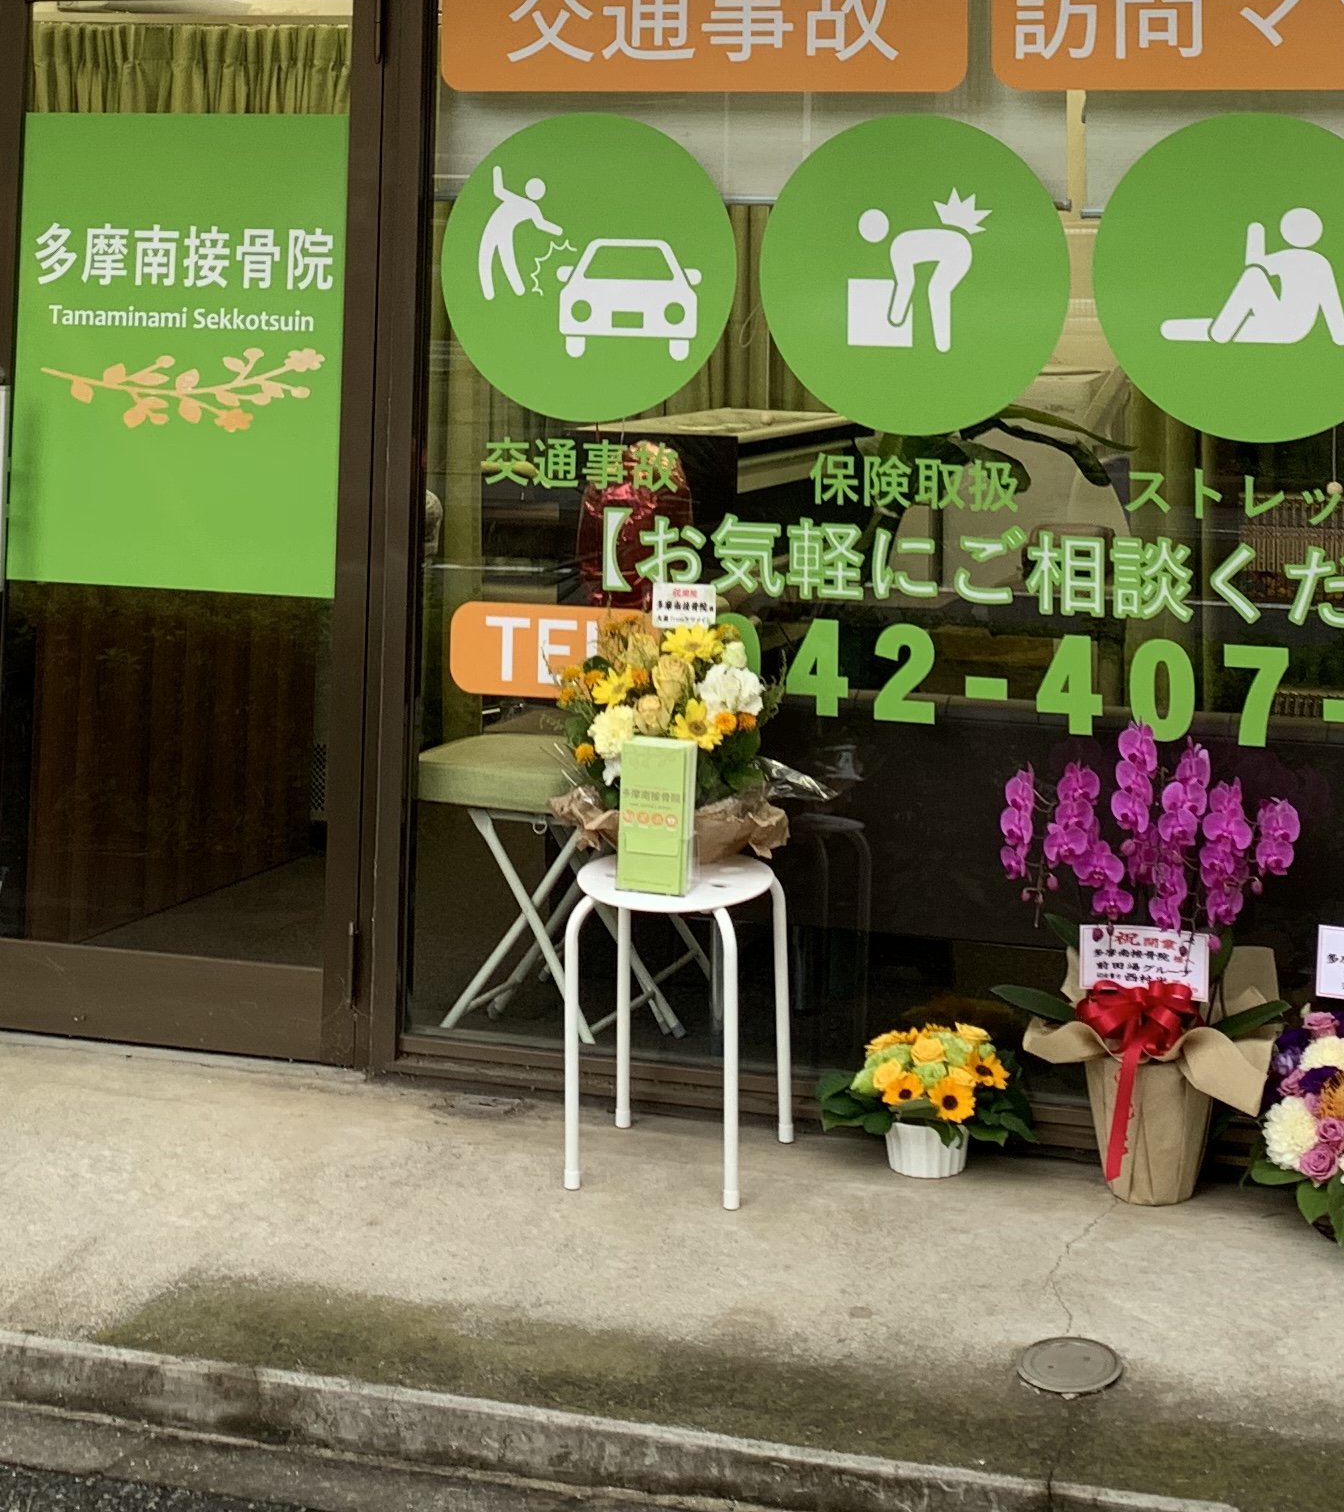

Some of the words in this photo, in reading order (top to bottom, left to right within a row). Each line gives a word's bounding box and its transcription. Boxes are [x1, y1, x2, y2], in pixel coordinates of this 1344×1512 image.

[34, 223, 334, 290] 多摩南接骨院
[49, 305, 188, 329] Tamaminami
[193, 308, 315, 331] Sekkotsuin
[484, 438, 679, 493] 交通事故
[809, 453, 1019, 513] 保険取扱
